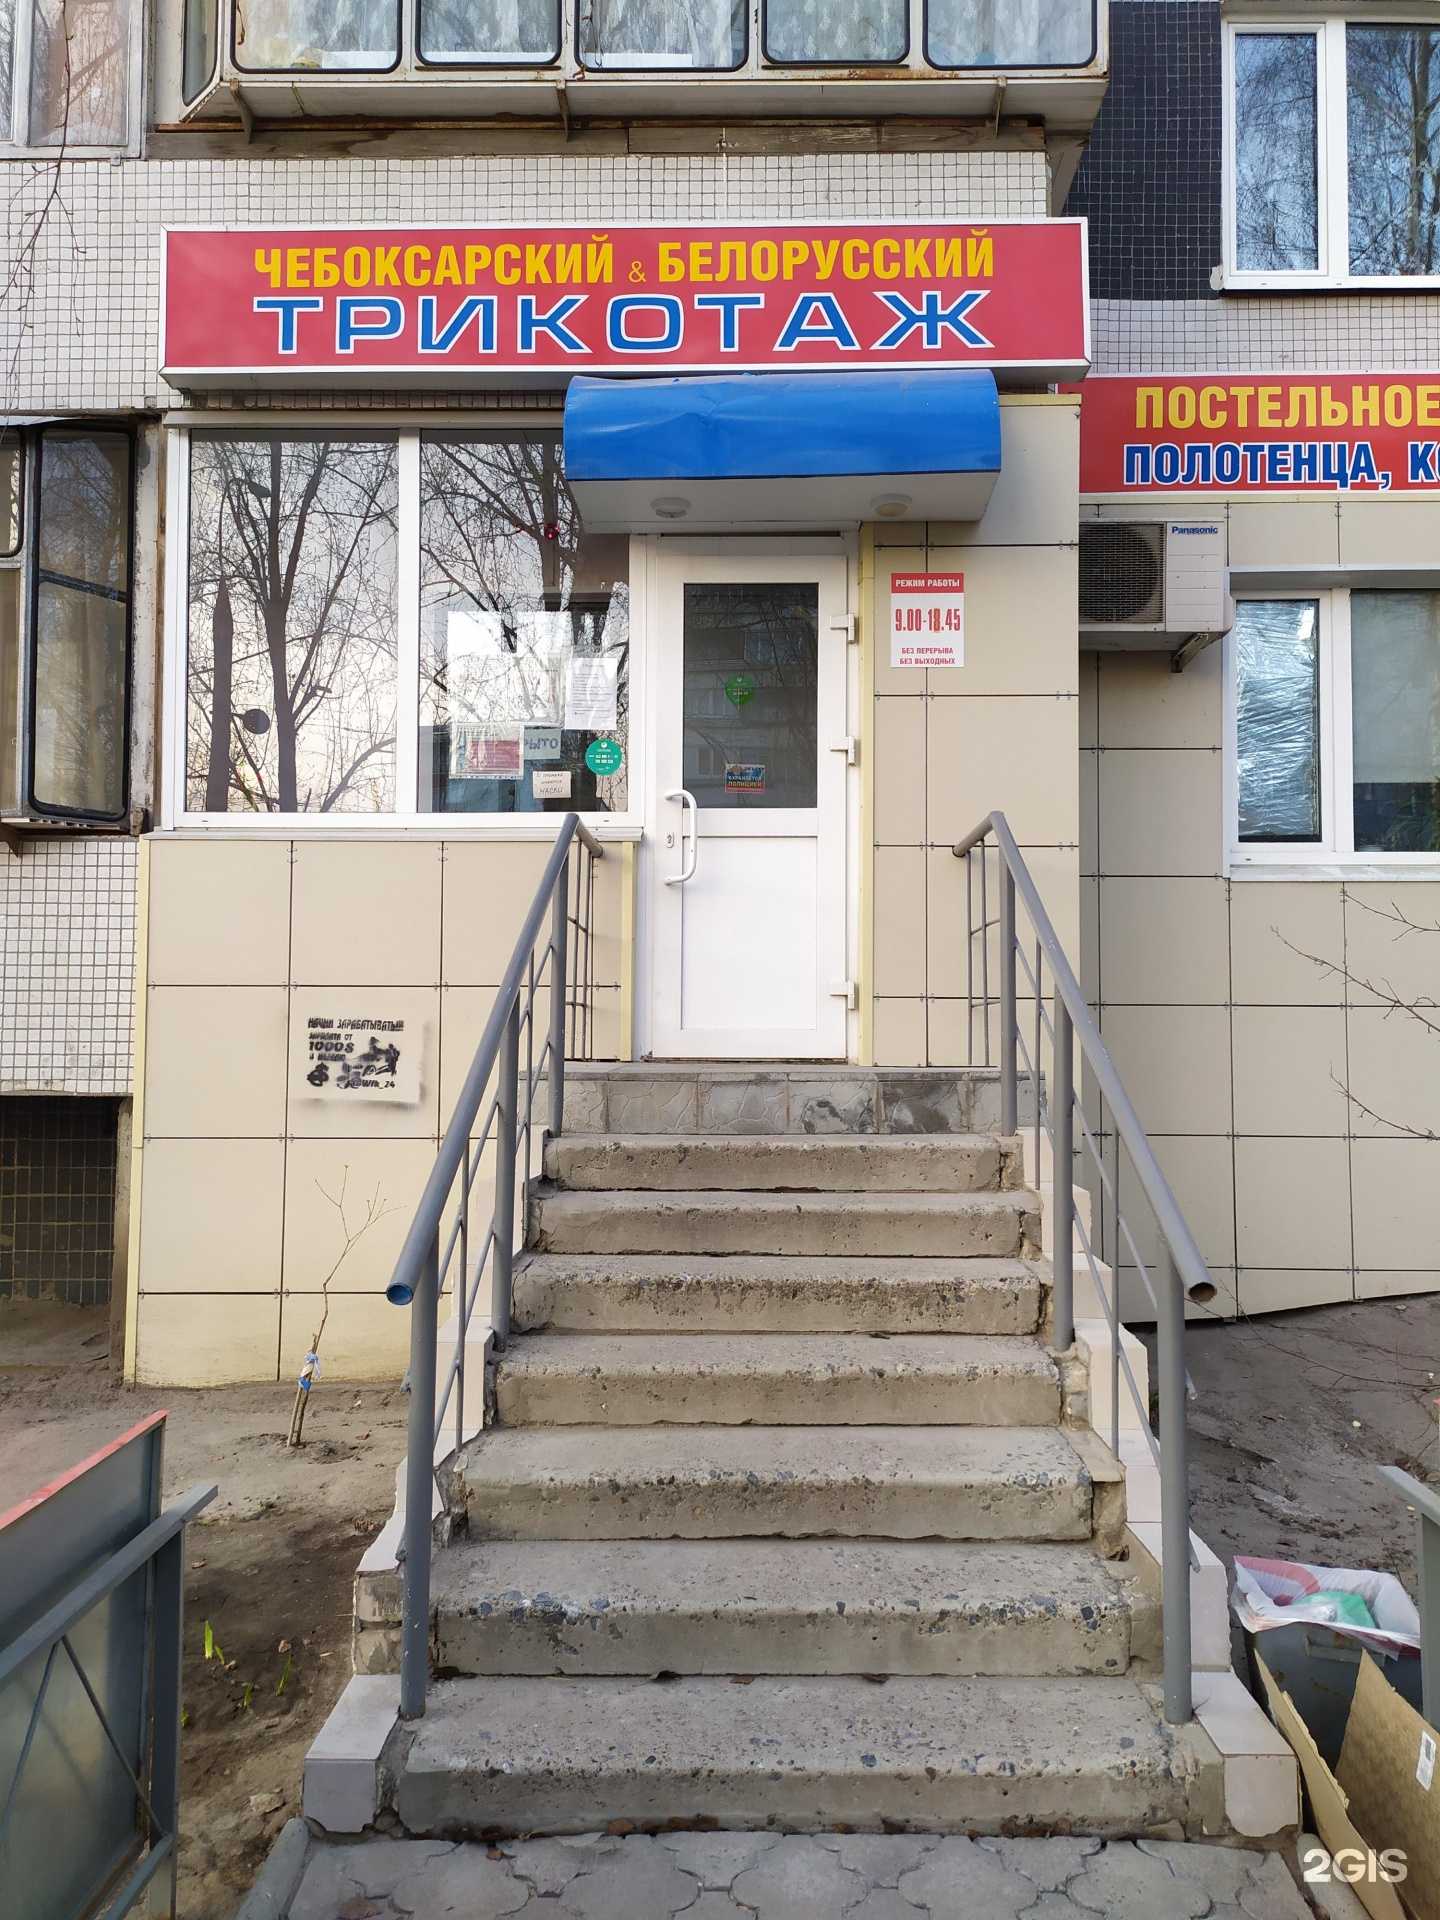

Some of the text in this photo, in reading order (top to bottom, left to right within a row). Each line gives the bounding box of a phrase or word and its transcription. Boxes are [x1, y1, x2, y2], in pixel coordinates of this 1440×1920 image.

[254, 229, 994, 288] ЧЕБОКСАРСКИЙ & БЕЛОРУССКИЙ
[252, 289, 996, 355] ТРИКОТАЖ
[1135, 384, 1440, 429] ПОСТЕЛЬНОЕ
[1123, 440, 1440, 491] ПОЛОТЕНЦА, К
[1171, 525, 1218, 535] Panasonic
[895, 578, 960, 588] РЕЖИМ РАБОТЫ
[895, 608, 961, 632] 9.00-18.45
[899, 657, 956, 666] БЕЗ ВЫХОДНЫХ
[901, 647, 954, 655] БЕЗ ПЕРЕРЫВА
